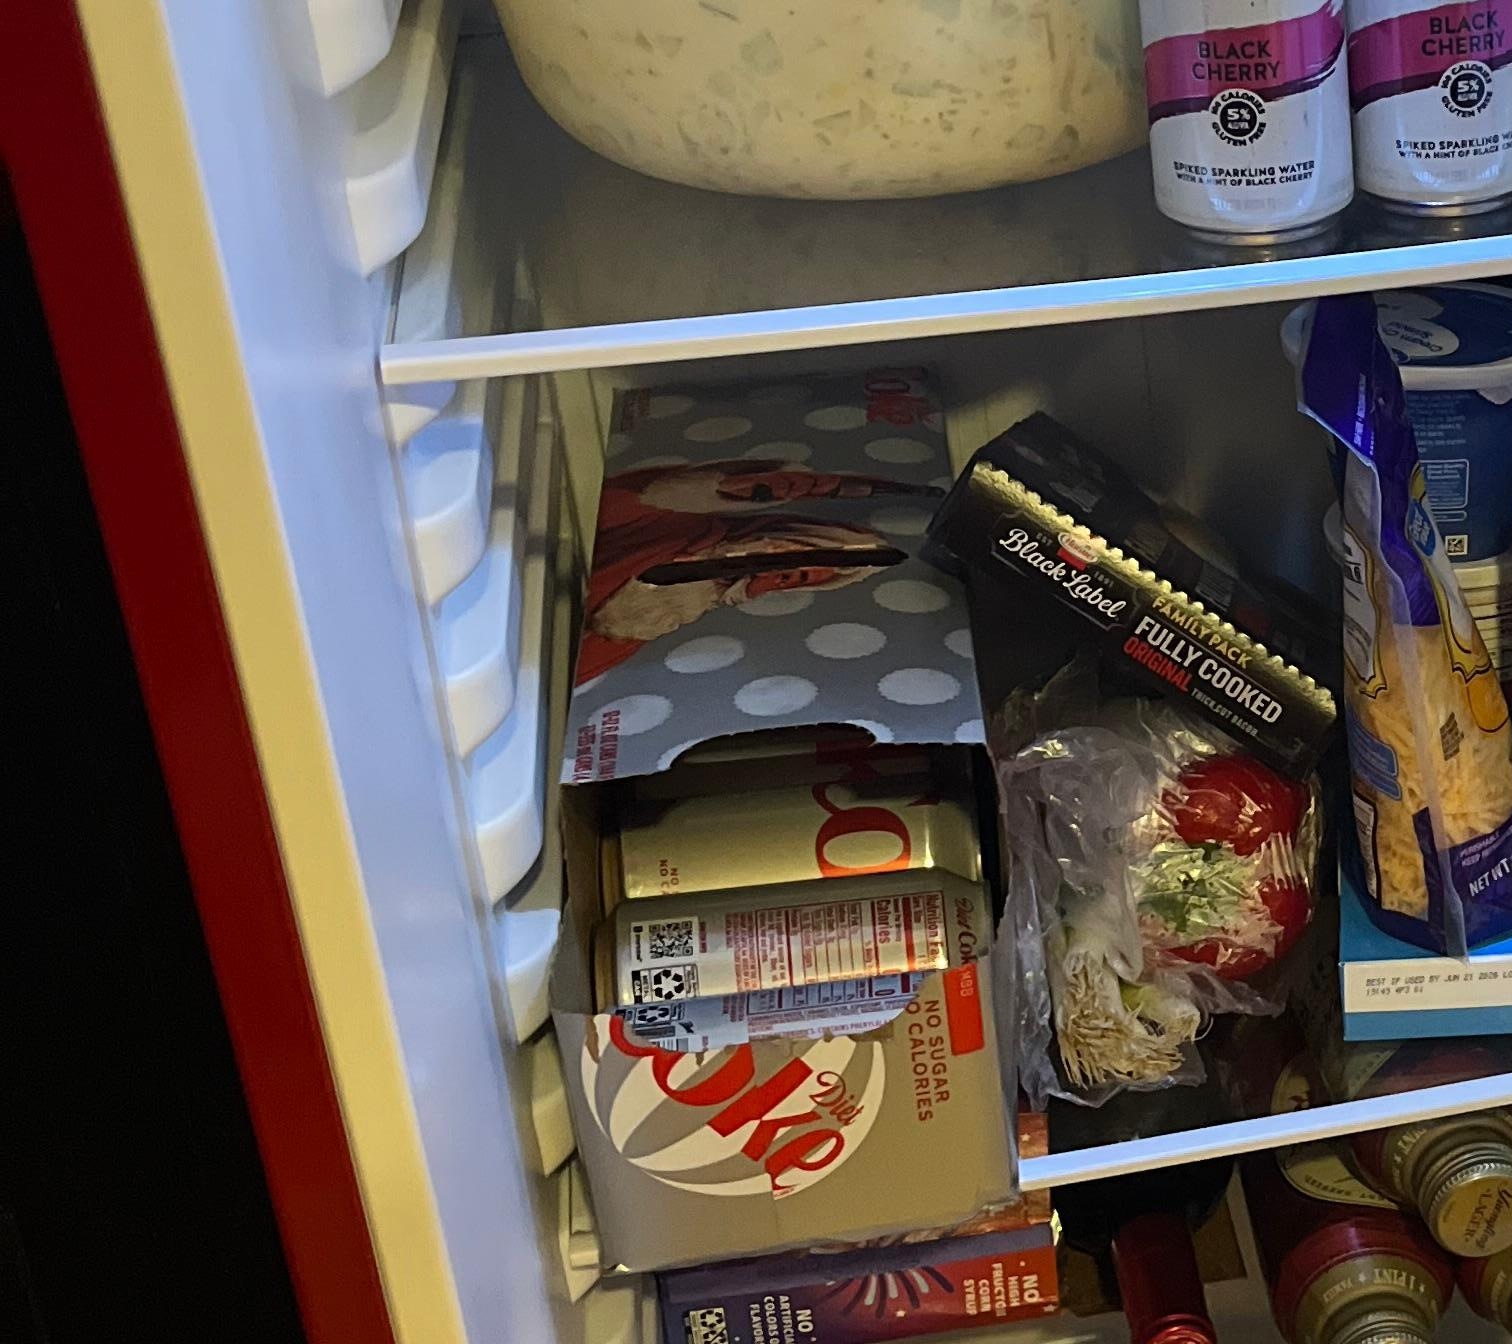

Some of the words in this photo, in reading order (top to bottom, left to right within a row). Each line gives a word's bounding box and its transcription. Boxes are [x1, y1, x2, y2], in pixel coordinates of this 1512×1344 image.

[1429, 9, 1498, 36] BLACK
[1198, 39, 1273, 61] BLACK
[1421, 29, 1505, 57] CHERRY
[1191, 60, 1281, 83] CHERRY
[1395, 138, 1436, 151] SPIKED
[1439, 132, 1500, 151] SPARKLING
[1173, 160, 1208, 177] SPIKED
[1210, 165, 1276, 178] SPARKLING
[1278, 159, 1315, 176] WATER
[998, 527, 1074, 582] Black
[1063, 569, 1128, 621] Label
[1152, 595, 1213, 645] FAMILY
[1208, 633, 1253, 670] PACK
[1123, 635, 1194, 695] ORIGINAL
[1133, 615, 1199, 669] FULLY
[1198, 658, 1284, 725] COOKED
[1468, 871, 1491, 898] NET
[875, 899, 892, 945] Calories
[924, 998, 943, 1029] NO
[907, 1022, 934, 1123] CALORIES
[927, 1035, 951, 1104] SUGAR
[808, 1070, 865, 1127] Diet
[962, 1278, 979, 1317] SYRUP
[1022, 1273, 1041, 1304] NO
[763, 1295, 780, 1337] COLORS
[795, 1308, 814, 1334] NO
